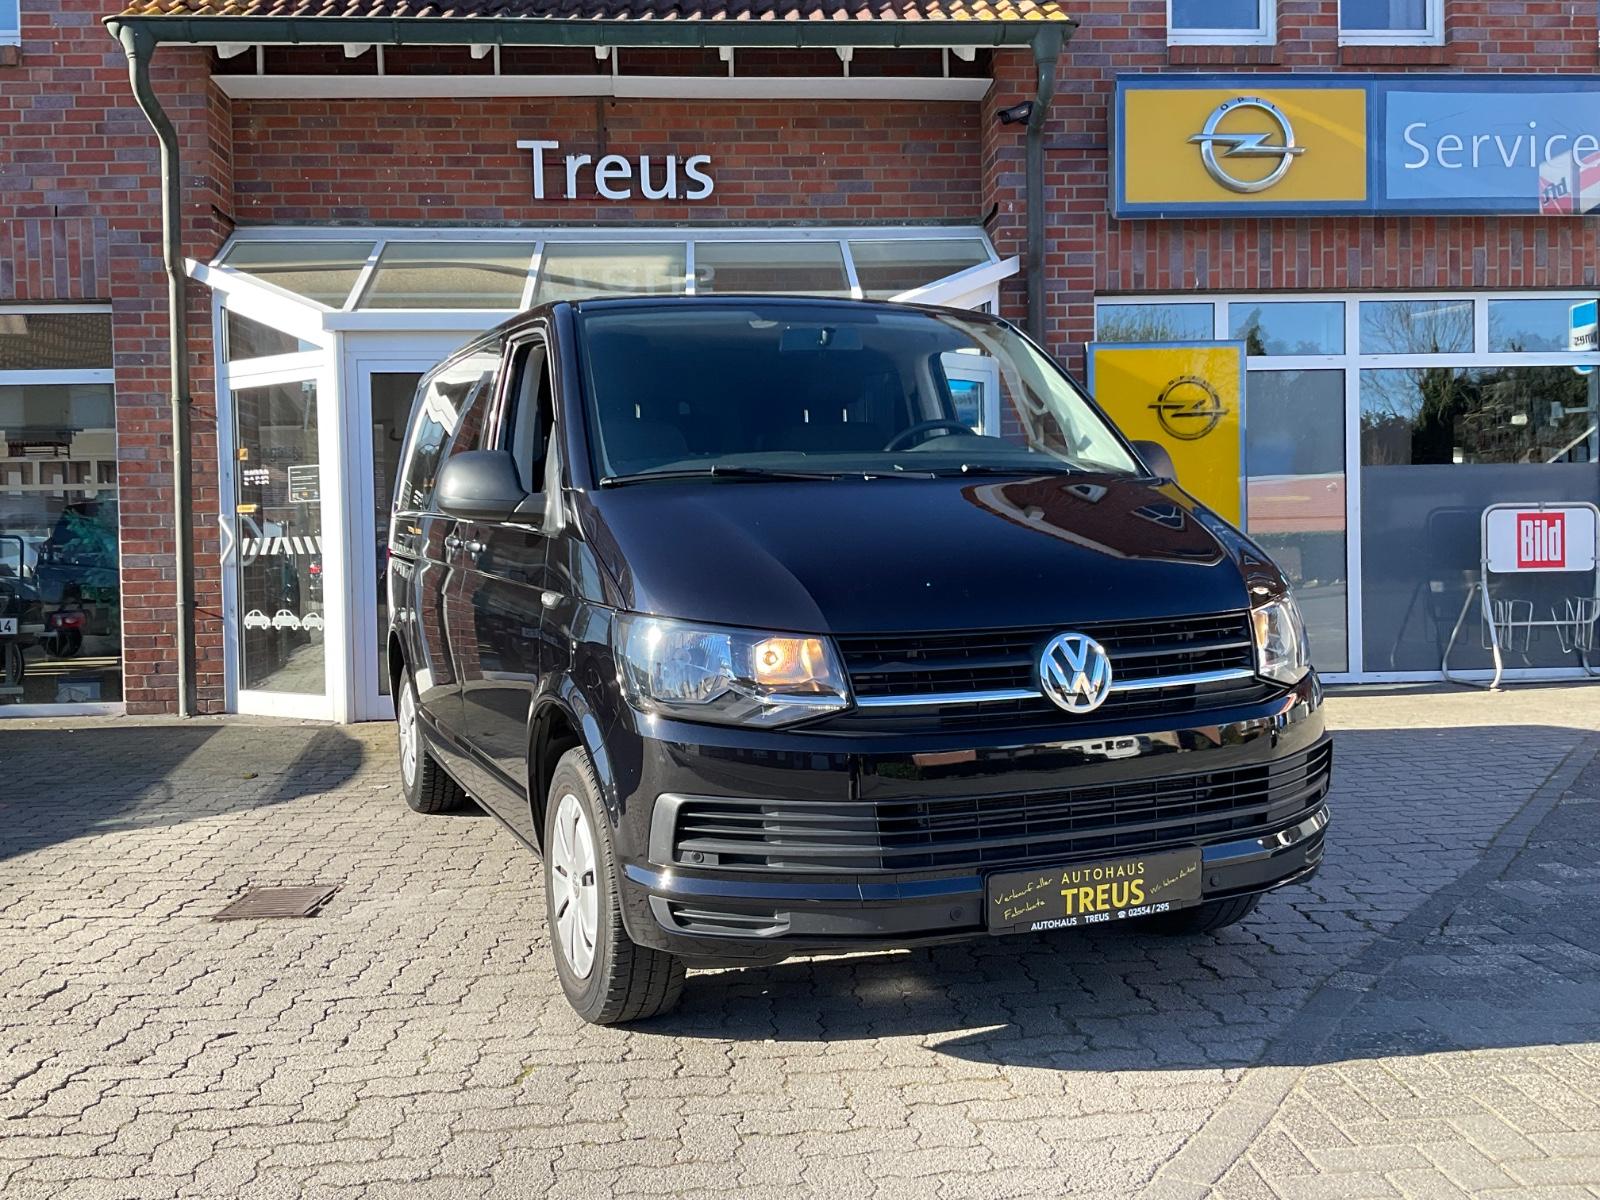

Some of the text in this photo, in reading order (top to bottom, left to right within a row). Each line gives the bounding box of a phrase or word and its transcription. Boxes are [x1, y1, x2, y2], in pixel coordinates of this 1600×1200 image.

[1403, 121, 1599, 168] Service
[516, 140, 714, 200] Treus
[1520, 519, 1562, 562] Bild
[1061, 862, 1145, 885] AUTOHAUS
[1060, 878, 1145, 915] TREUS
[1030, 917, 1077, 931] AUTOHAUS
[1085, 912, 1110, 924] TREUS
